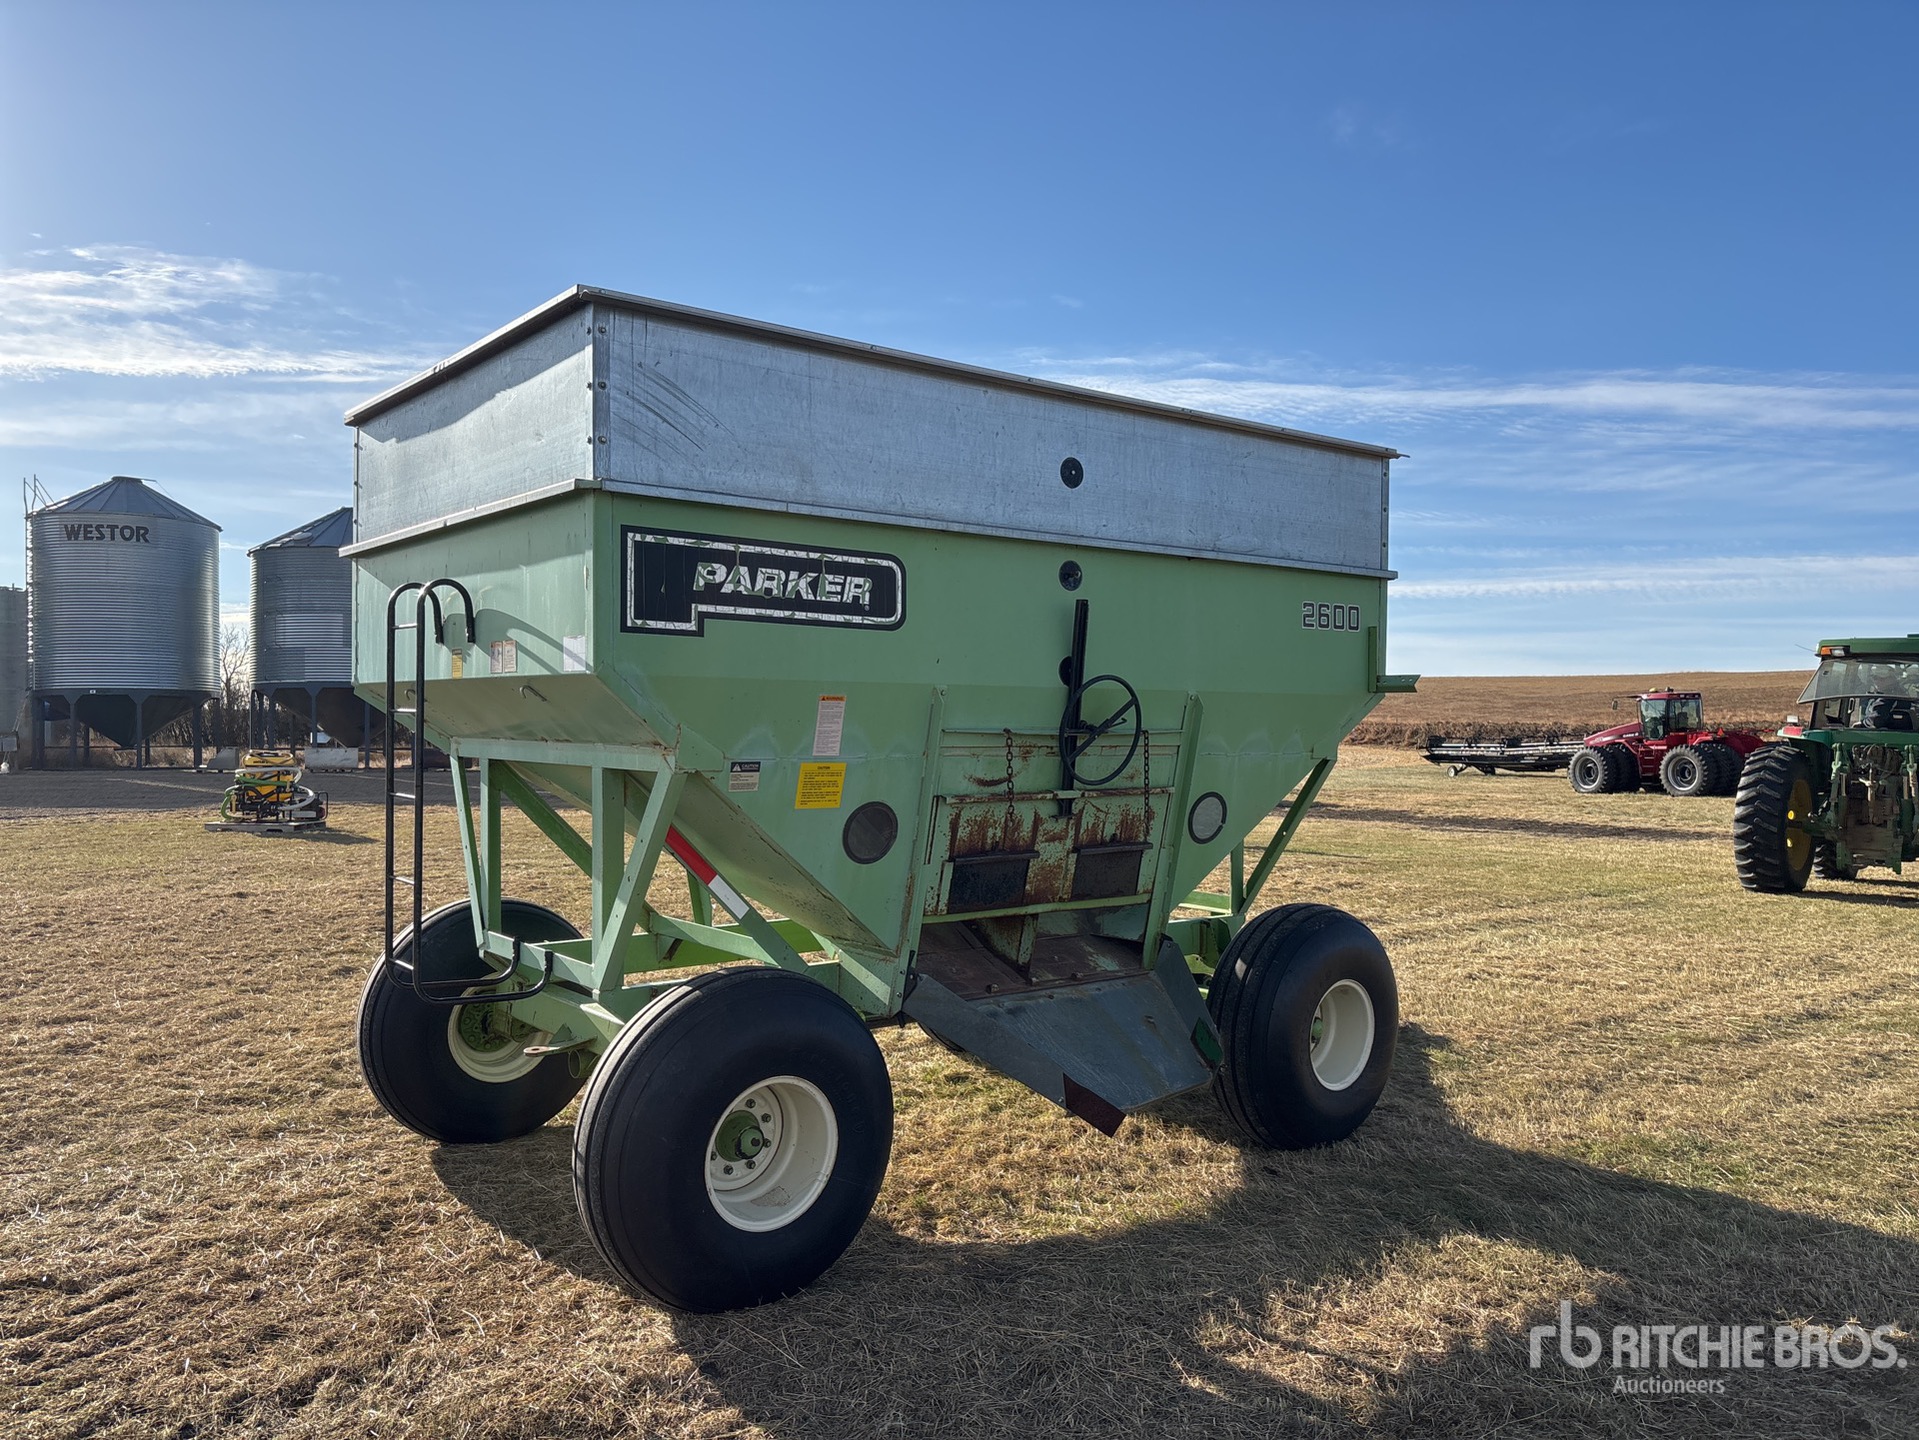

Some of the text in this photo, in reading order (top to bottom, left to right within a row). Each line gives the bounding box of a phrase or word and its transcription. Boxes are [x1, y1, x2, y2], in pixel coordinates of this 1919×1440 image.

[64, 524, 150, 543] WESTOR
[693, 562, 872, 604] PARKER
[1302, 601, 1360, 632] 2600
